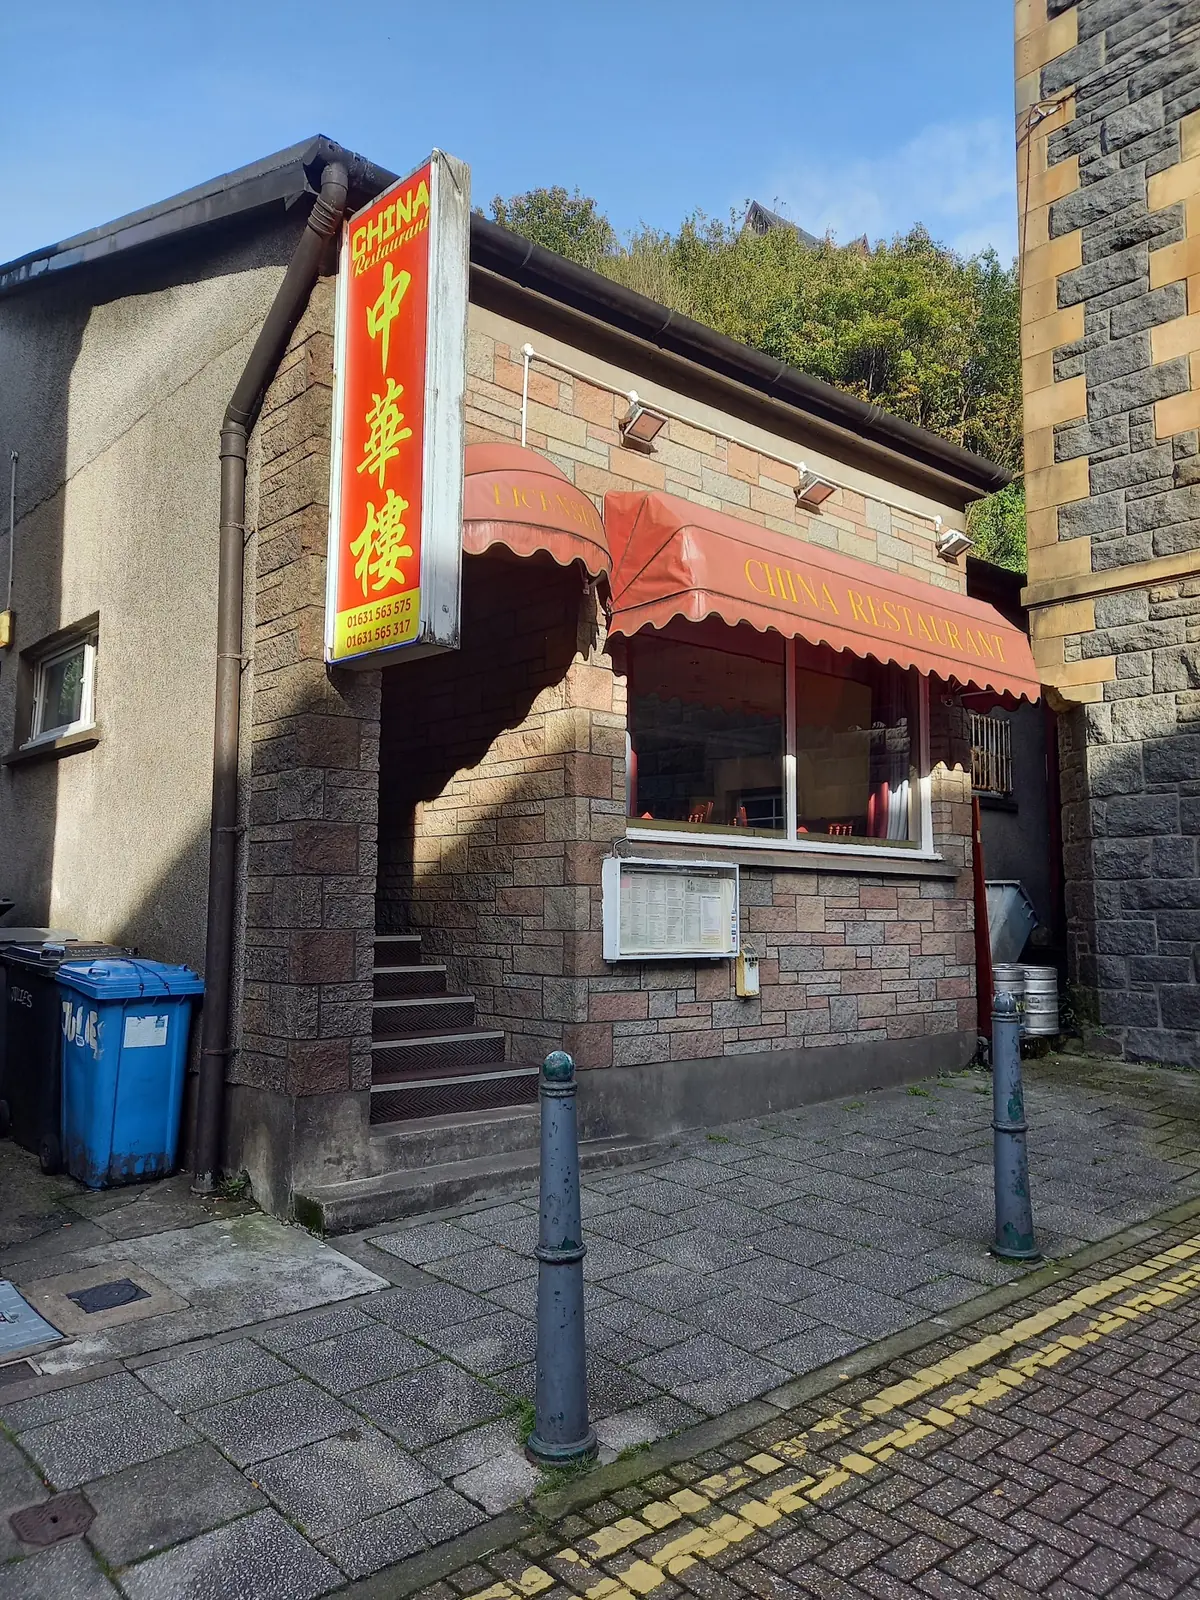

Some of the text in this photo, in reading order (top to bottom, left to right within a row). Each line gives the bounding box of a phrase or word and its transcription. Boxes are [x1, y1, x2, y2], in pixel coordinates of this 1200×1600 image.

[352, 180, 430, 261] CHINA
[352, 210, 430, 277] Restaurant
[349, 260, 414, 599] 中華樓
[346, 619, 411, 648] 01631 565 317
[347, 598, 411, 628] 01631 563 575
[744, 558, 1007, 664] CHINA RESTAURANT
